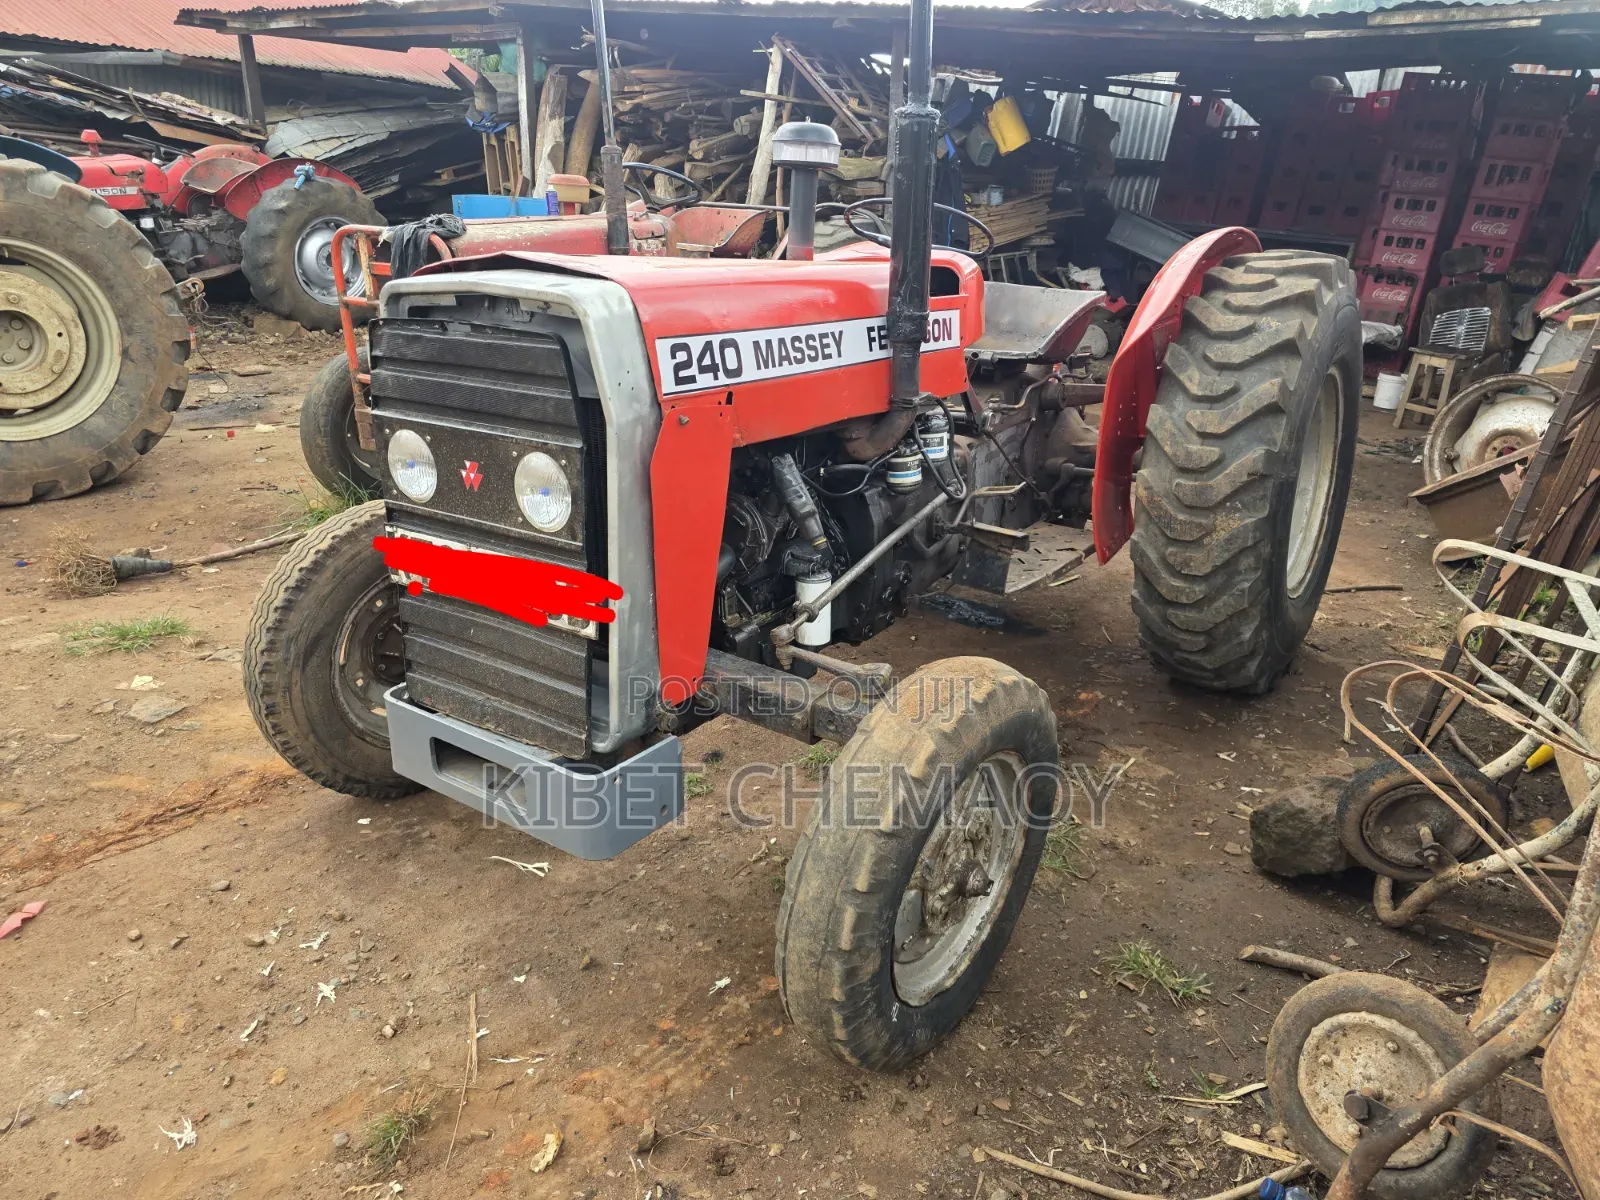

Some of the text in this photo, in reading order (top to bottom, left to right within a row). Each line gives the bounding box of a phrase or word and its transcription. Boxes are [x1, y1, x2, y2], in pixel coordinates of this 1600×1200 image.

[669, 317, 952, 387] 240 MASSEY FESON
